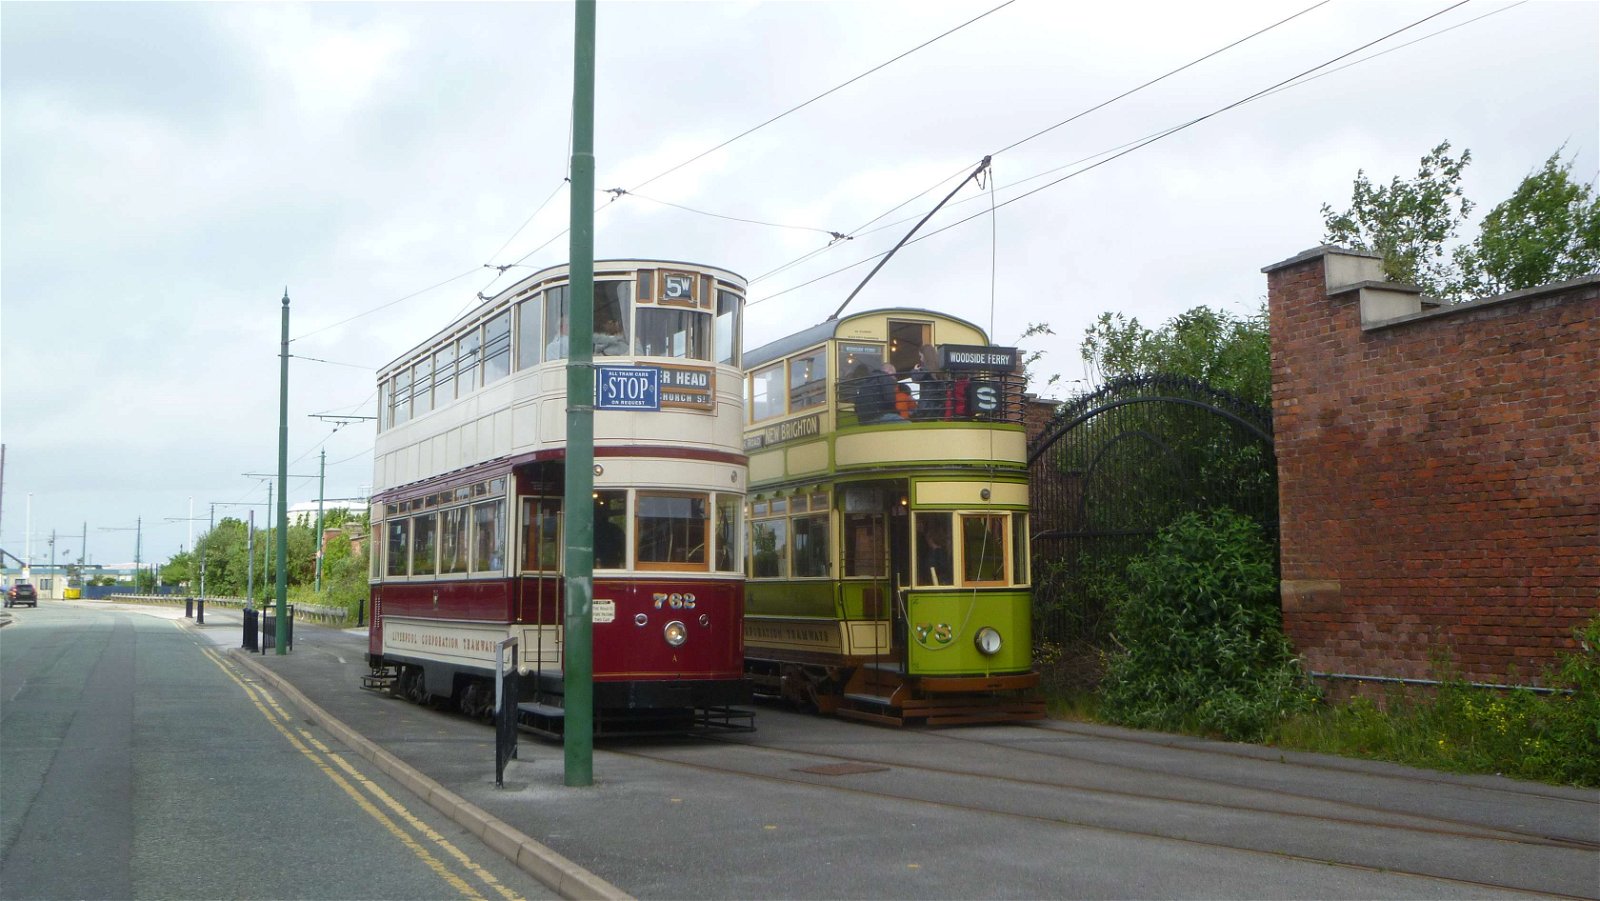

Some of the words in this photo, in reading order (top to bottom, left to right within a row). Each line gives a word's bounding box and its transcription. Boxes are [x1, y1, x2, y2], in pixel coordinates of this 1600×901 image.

[950, 351, 986, 364] WOODSIDE
[987, 353, 1010, 365] FERRY
[608, 376, 649, 399] STOP
[676, 371, 707, 386] HEAD
[976, 386, 997, 410] S
[765, 425, 780, 445] NEW
[781, 416, 818, 440] BRIGHTON
[652, 592, 696, 610] 762
[392, 631, 417, 644] LIVERPOOL
[421, 634, 459, 649] CORPORATION
[463, 638, 497, 654] TRAMWAYS
